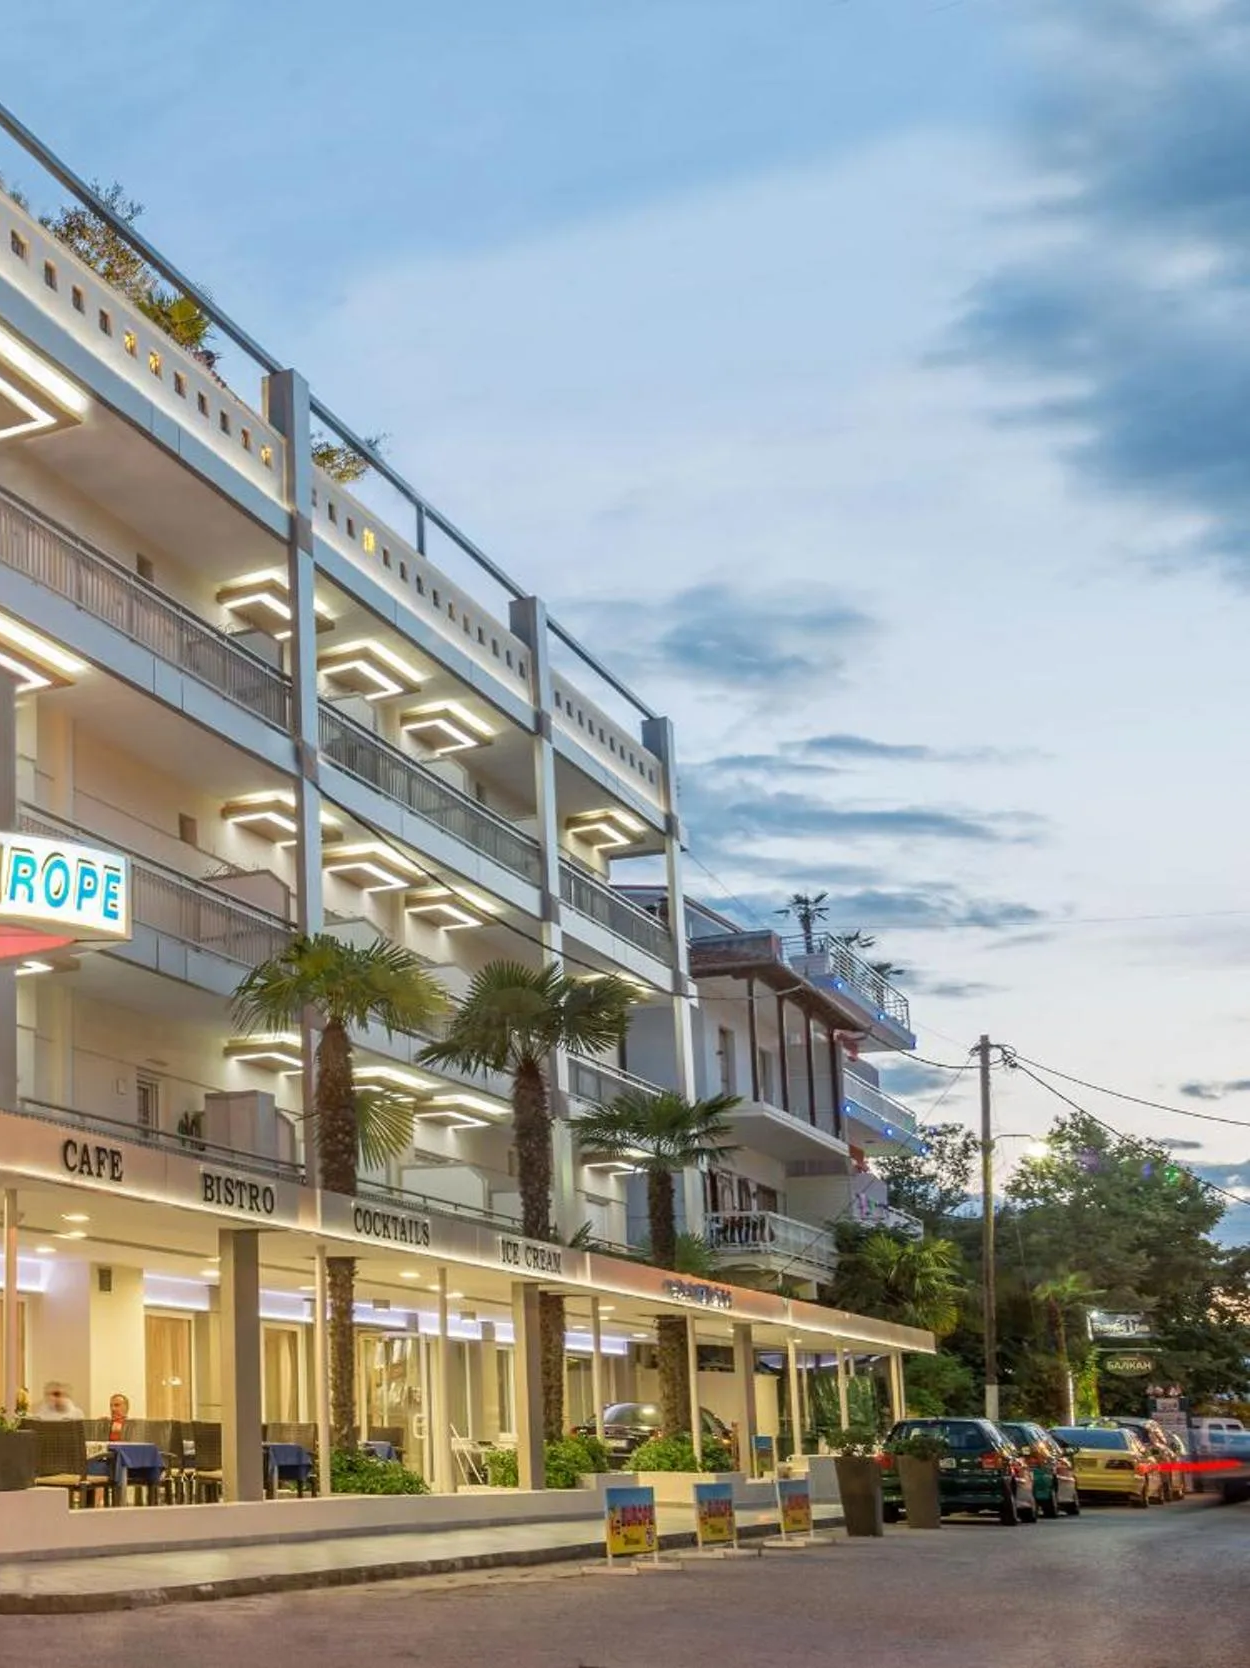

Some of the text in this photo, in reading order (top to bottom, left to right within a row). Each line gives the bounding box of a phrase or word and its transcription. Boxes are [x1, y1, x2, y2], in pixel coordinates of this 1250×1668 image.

[63, 1139, 124, 1182] CAFE
[202, 1172, 275, 1215] BISTRO
[353, 1207, 431, 1247] COCKTAILS
[501, 1239, 563, 1274] ICE CREAM
[1107, 1361, 1151, 1370] БАЛКАН
